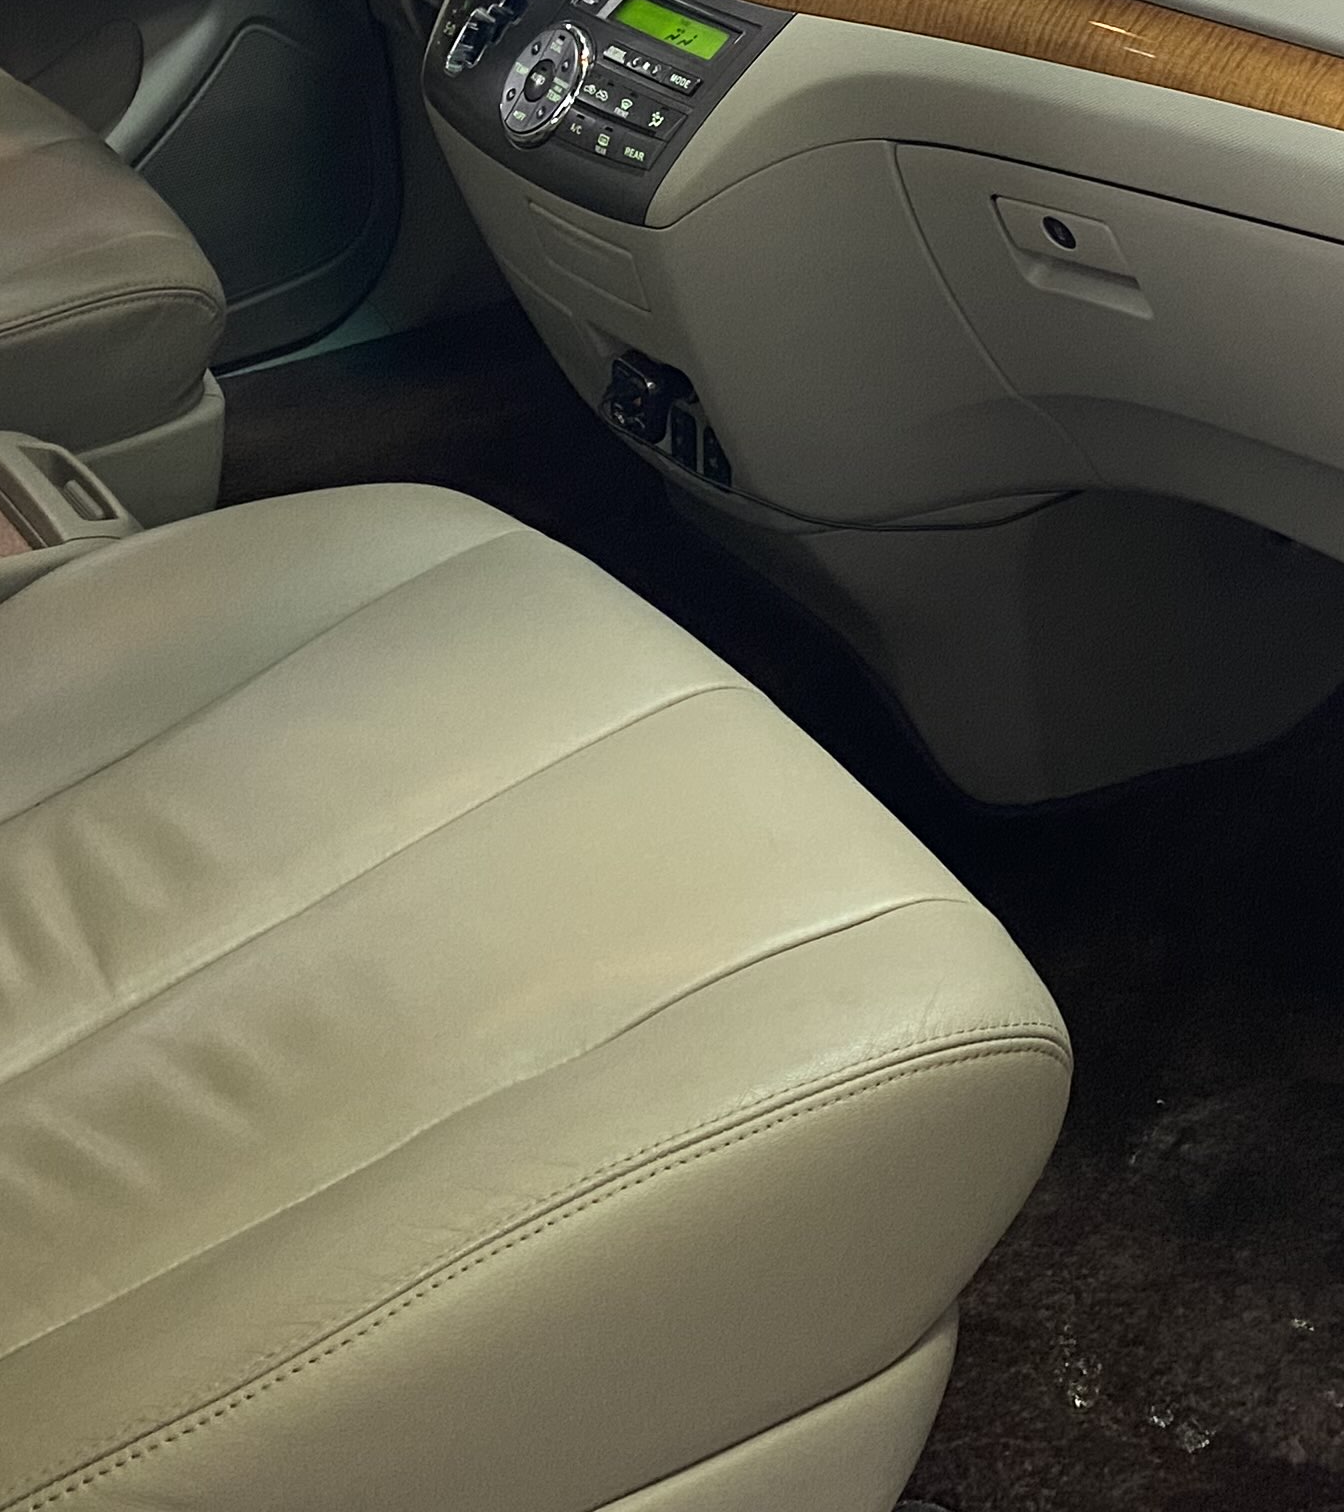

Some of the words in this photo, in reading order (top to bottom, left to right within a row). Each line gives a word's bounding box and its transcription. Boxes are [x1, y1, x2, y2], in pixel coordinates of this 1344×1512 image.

[669, 73, 692, 89] MODE
[570, 123, 582, 135] A/C
[624, 146, 645, 162] REAR
